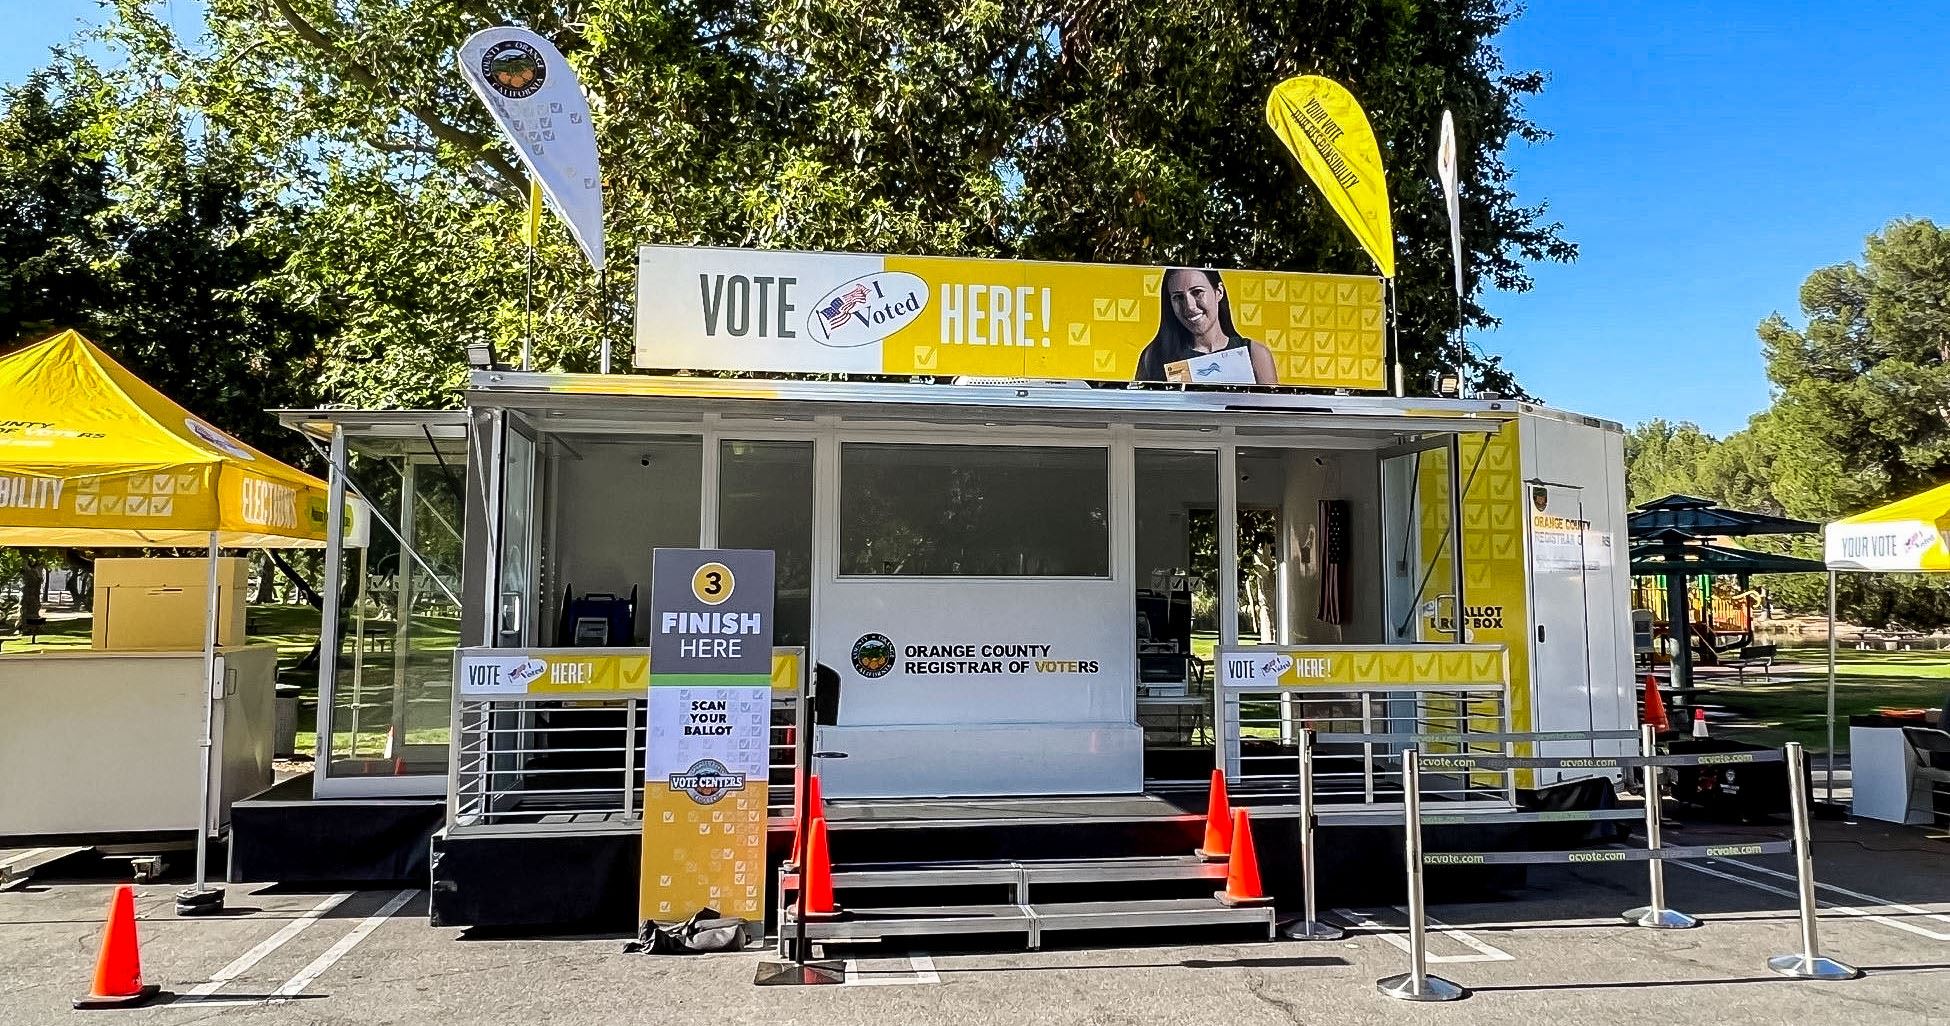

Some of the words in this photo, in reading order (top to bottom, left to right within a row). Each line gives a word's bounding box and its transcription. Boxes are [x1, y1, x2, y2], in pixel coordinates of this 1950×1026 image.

[1303, 97, 1328, 124] YOUR
[1321, 117, 1344, 143] VOTE
[872, 280, 885, 299] I
[699, 273, 797, 339] VOTE
[939, 283, 1051, 348] HERE!
[852, 291, 921, 329] Voted
[1842, 536, 1868, 558] YOUR
[1871, 534, 1897, 557] VOTE
[704, 572, 722, 595] 3
[661, 612, 761, 635] FINISH
[1473, 617, 1504, 629] BOX
[680, 638, 742, 658] HERE
[904, 645, 976, 658] ORANGE
[981, 645, 1051, 658] COUNTY
[469, 665, 501, 686] VOTE
[550, 662, 593, 685] HERE!
[904, 660, 1003, 674] REGISTRAR
[1008, 660, 1030, 674] OF
[1034, 660, 1099, 674] VOTERS
[1228, 660, 1255, 679] VOTE
[1296, 658, 1332, 678] HERE!
[691, 701, 727, 711] SCAN
[689, 713, 727, 724] YOUR
[684, 726, 734, 736] BALLOT
[672, 776, 698, 788] VOTE
[698, 776, 743, 788] CENTERS
[1423, 854, 1484, 864] ocvote.com
[1568, 851, 1626, 862] ocvote.com
